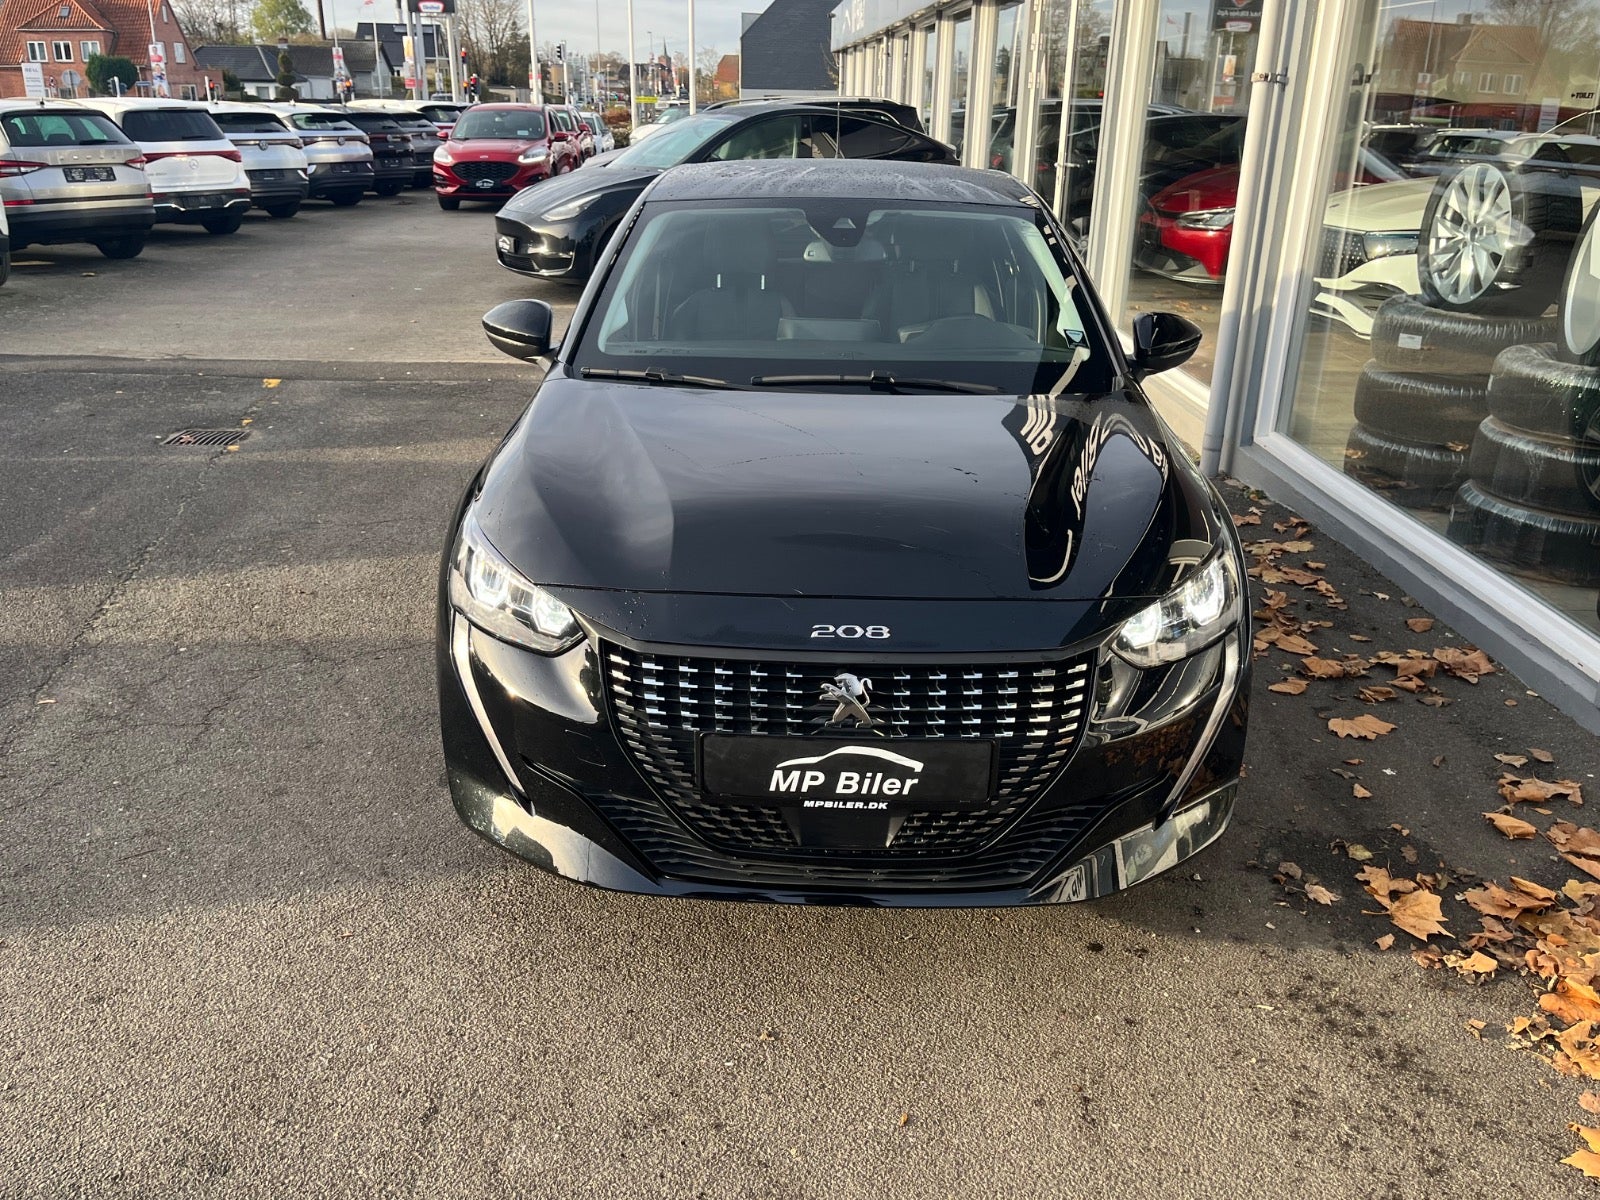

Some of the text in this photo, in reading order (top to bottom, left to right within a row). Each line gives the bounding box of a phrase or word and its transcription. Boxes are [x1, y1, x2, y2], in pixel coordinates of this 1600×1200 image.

[810, 625, 891, 639] 208
[769, 769, 919, 796] MP Biler
[803, 800, 888, 810] MPBILER.DK
